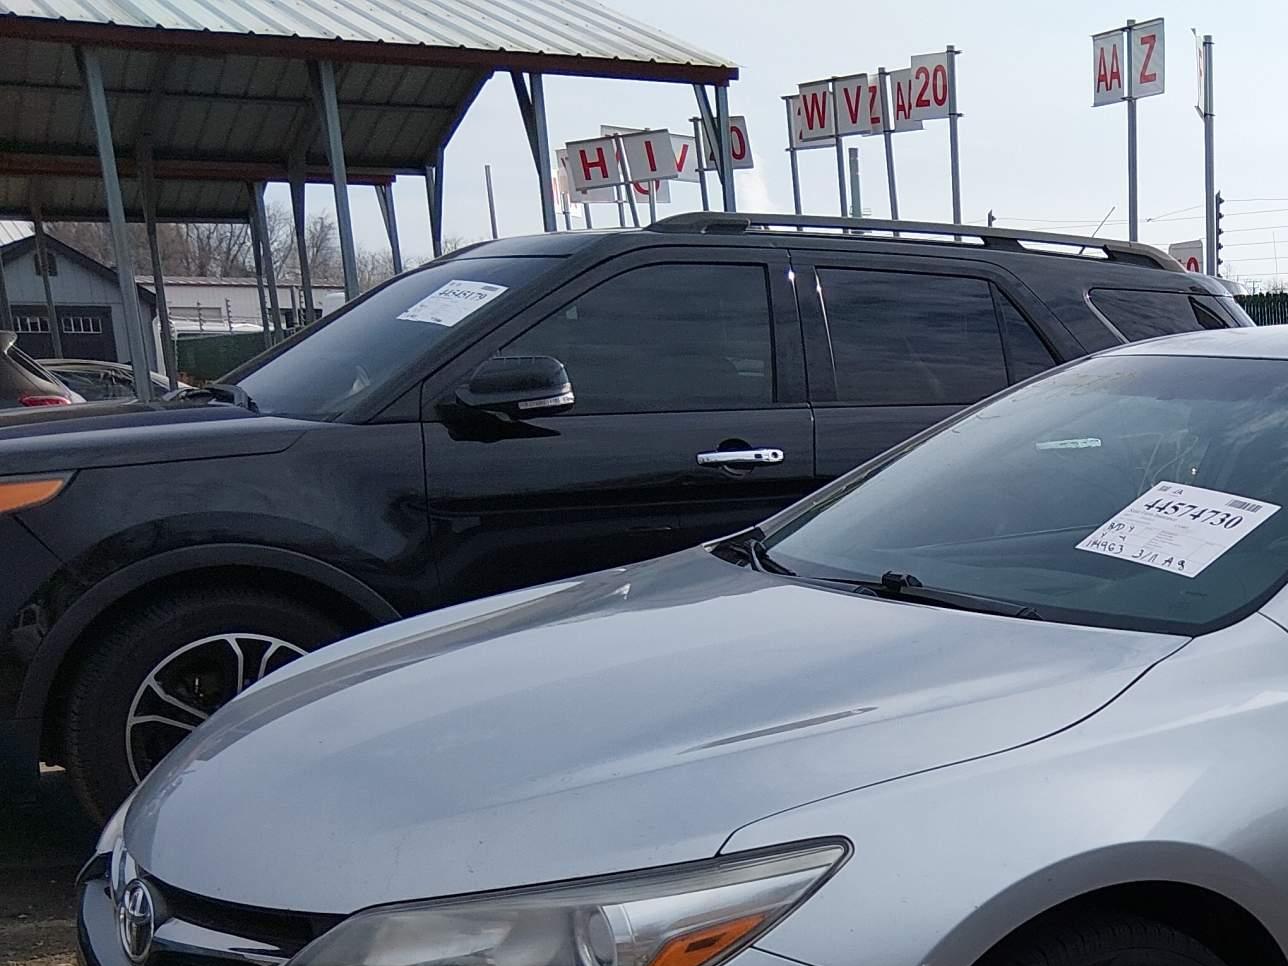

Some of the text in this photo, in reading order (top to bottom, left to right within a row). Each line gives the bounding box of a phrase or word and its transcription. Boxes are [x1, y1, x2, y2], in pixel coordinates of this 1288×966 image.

[1097, 44, 1121, 93] AA
[1140, 34, 1157, 84] Z
[843, 85, 861, 124] V
[915, 64, 948, 108] 20
[803, 90, 826, 131] W
[580, 147, 608, 180] H
[644, 140, 657, 172] I
[1144, 498, 1243, 530] 44574730
